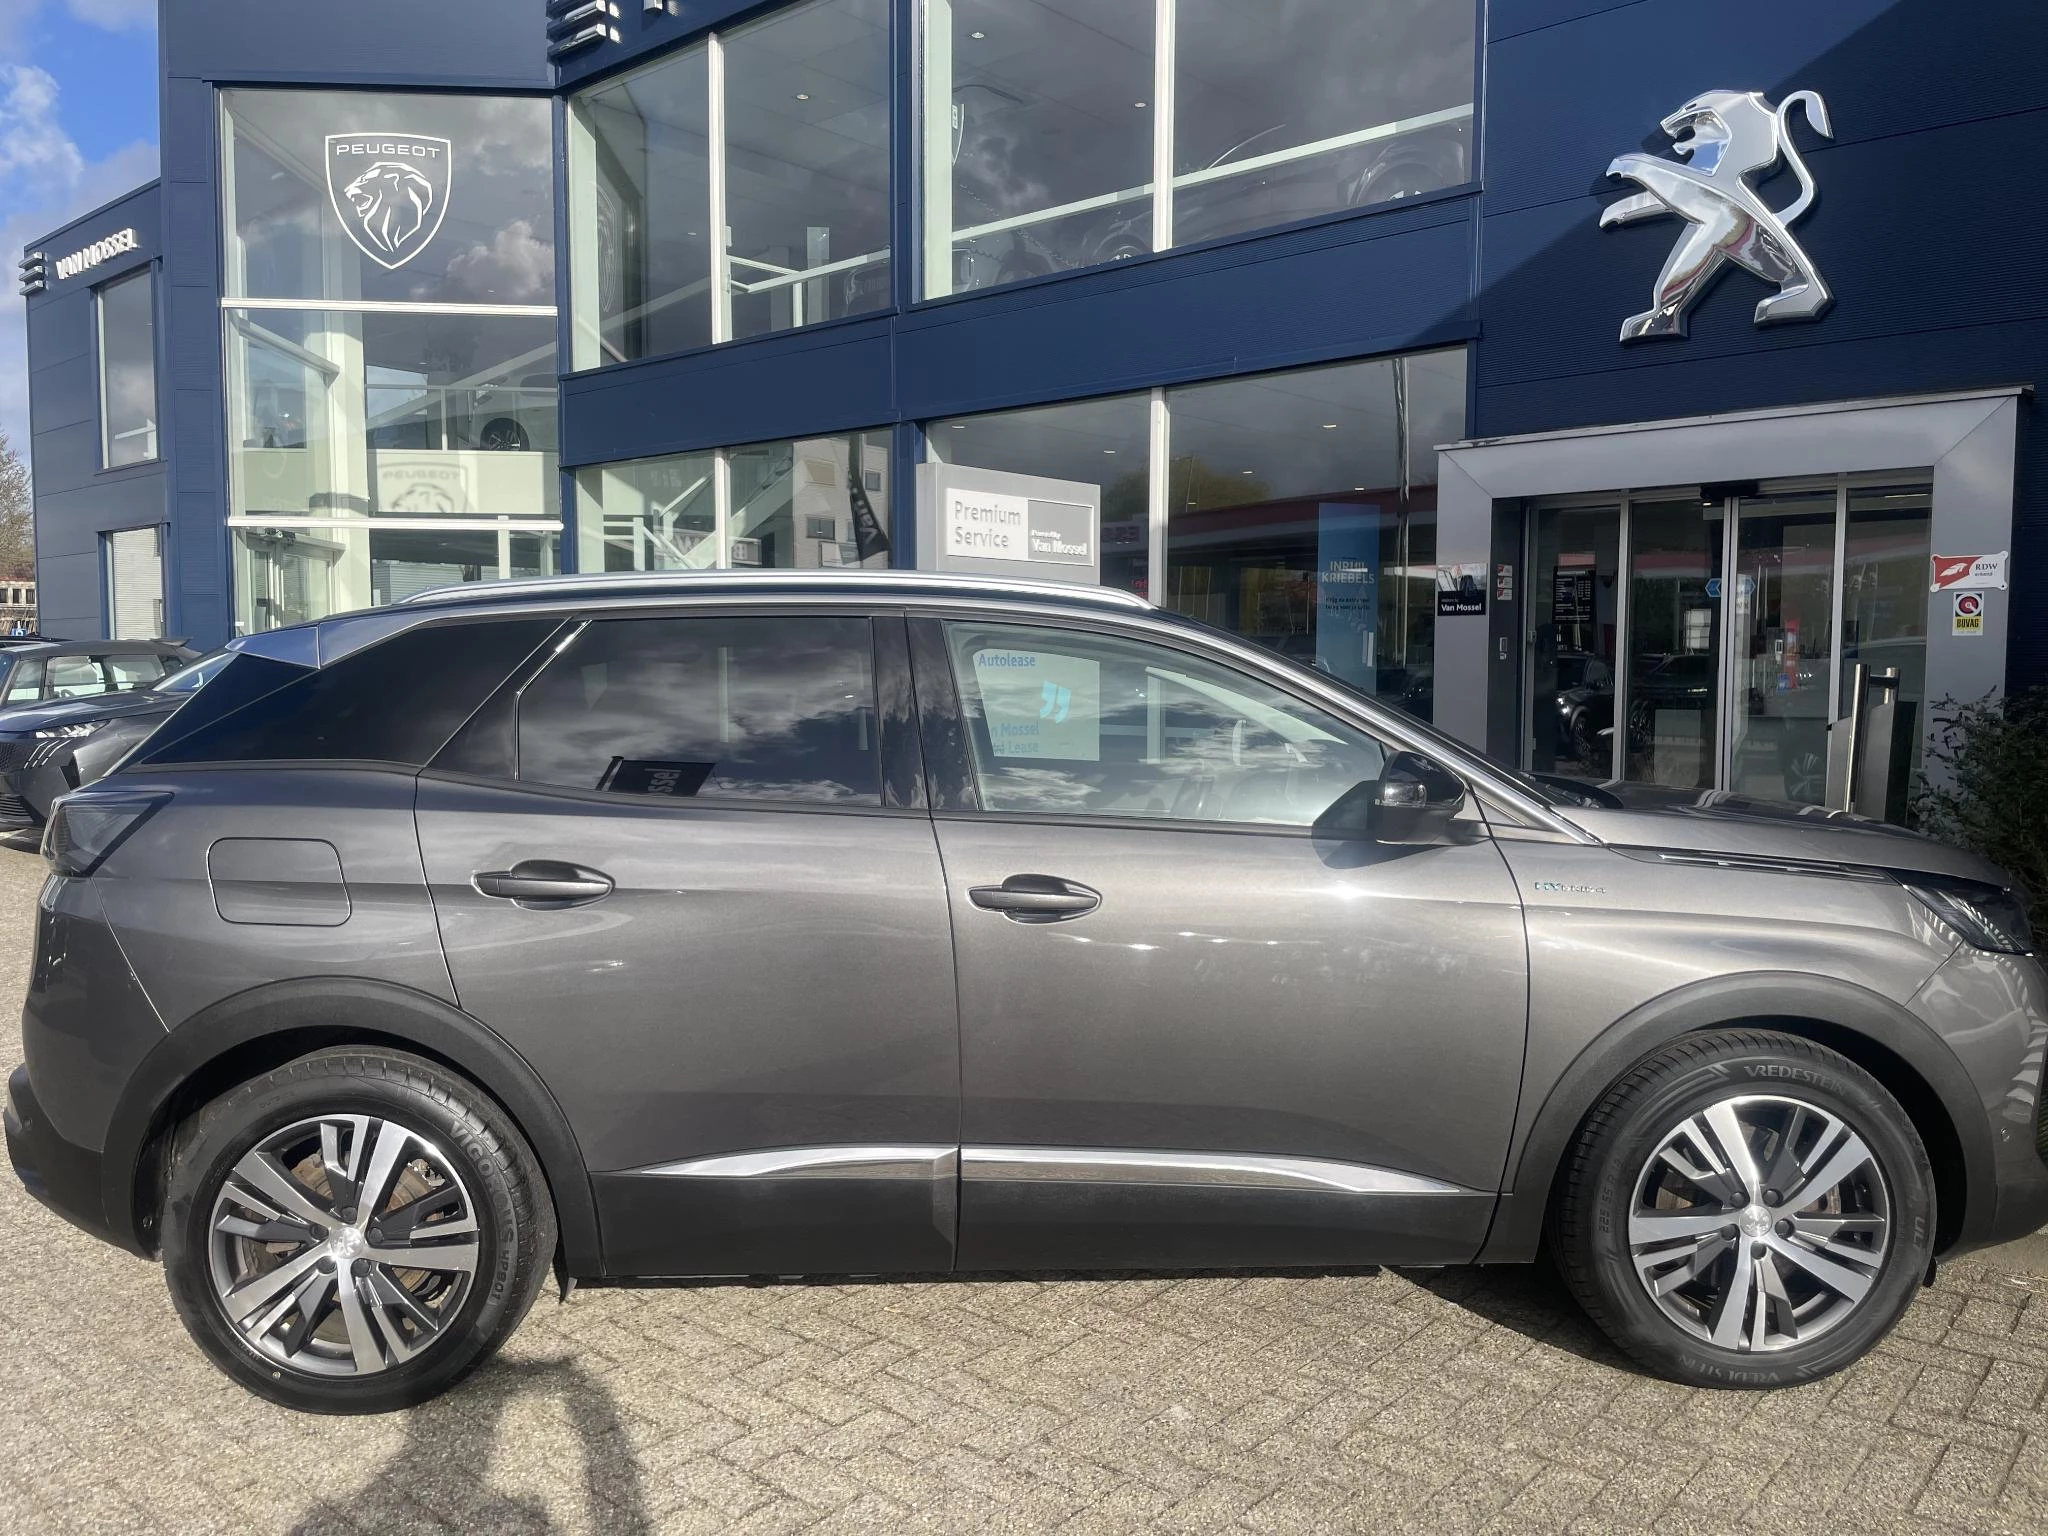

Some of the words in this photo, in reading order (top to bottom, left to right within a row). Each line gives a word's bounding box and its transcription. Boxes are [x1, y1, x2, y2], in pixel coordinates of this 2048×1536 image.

[336, 143, 441, 158] PEUGEOT
[55, 251, 83, 279] VAN
[82, 227, 138, 269] MOSSEL
[954, 500, 1022, 527] Premium
[954, 526, 1010, 549] Service
[1031, 538, 1052, 553] Van
[1052, 540, 1088, 557] Mossel
[1975, 563, 1999, 571] RDW
[1321, 571, 1376, 585] KRIEBELS
[1441, 603, 1455, 612] Van
[1456, 602, 1482, 612] Mossel
[1956, 618, 1980, 629] BOVAG
[978, 652, 1037, 668] Autolease
[1743, 1064, 1846, 1097] VREDESTEIN
